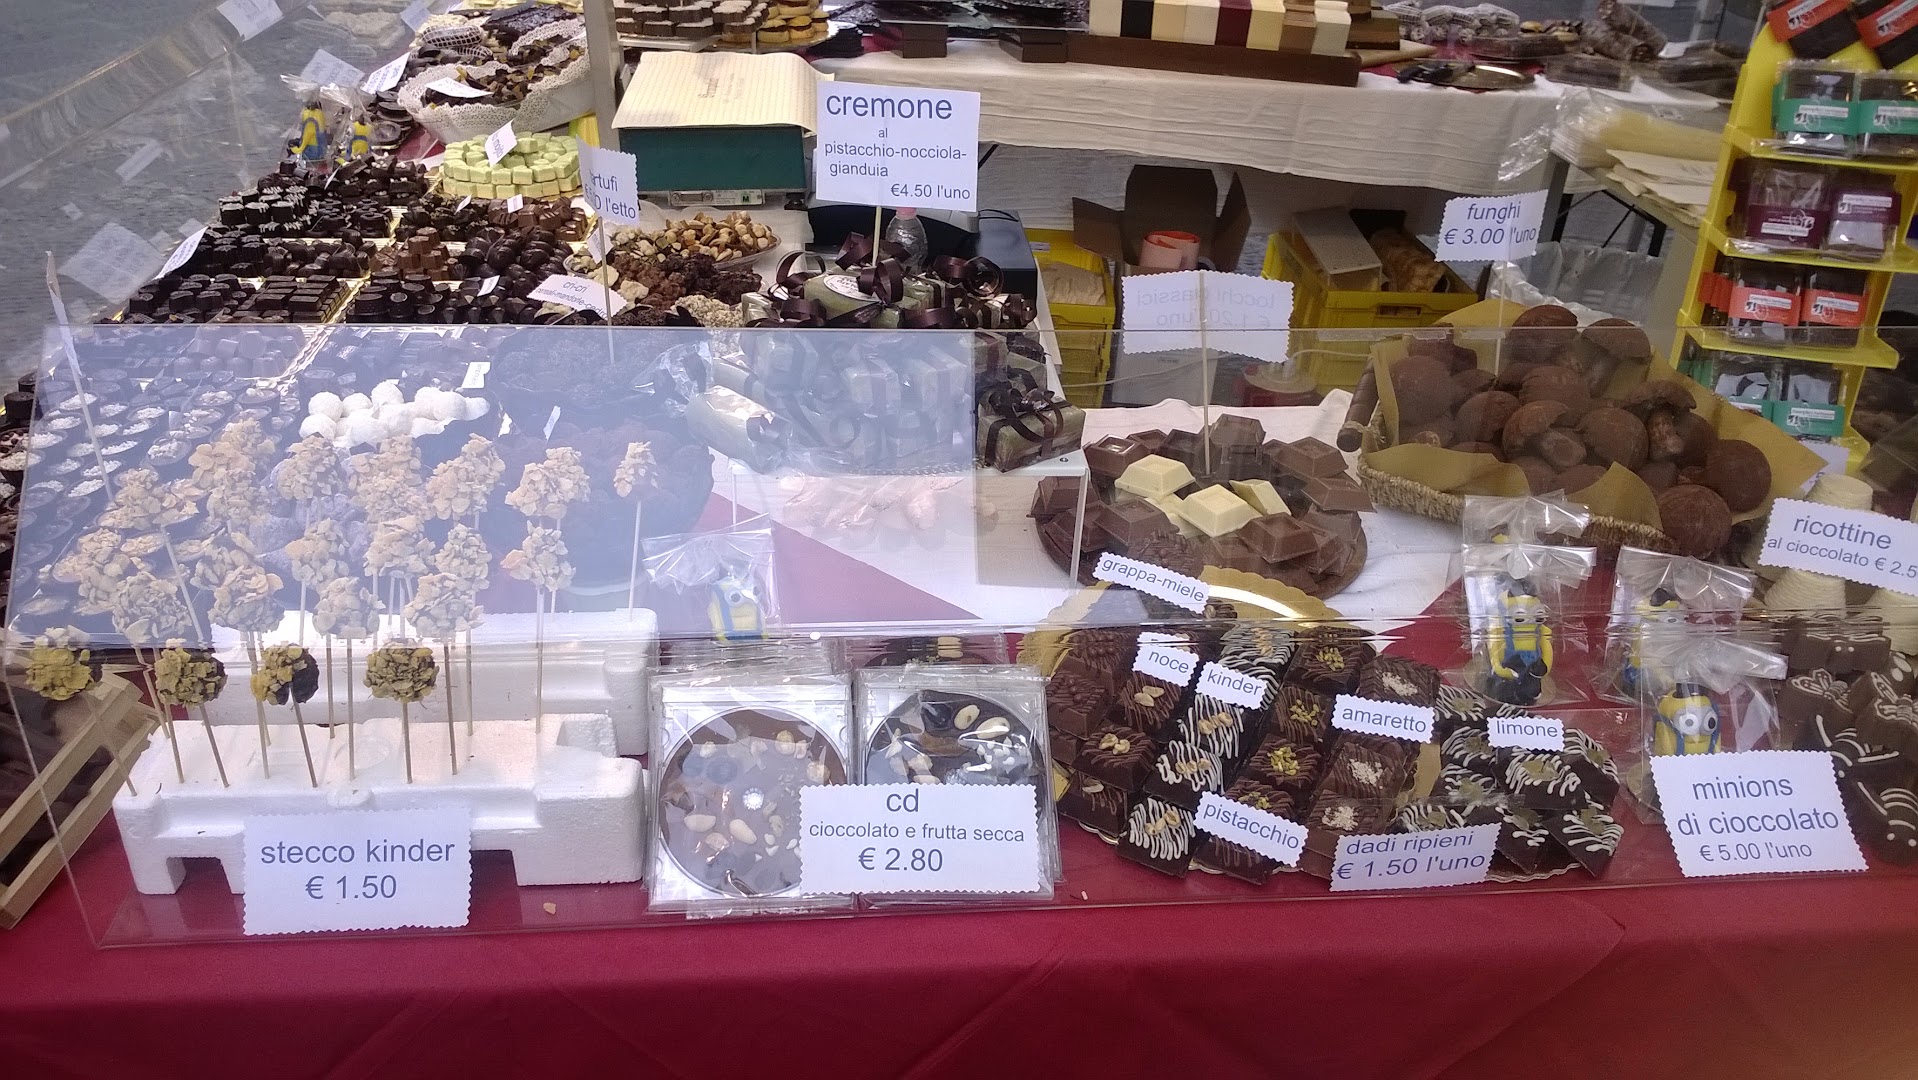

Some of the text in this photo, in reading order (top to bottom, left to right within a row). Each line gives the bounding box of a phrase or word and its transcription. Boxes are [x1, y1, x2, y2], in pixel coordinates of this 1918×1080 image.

[826, 94, 953, 120] cremone
[878, 128, 888, 138] al
[824, 141, 967, 160] pistacchio-nocciola-
[829, 161, 889, 177] gianduia
[890, 183, 971, 200] €4.50 l'uno
[605, 197, 636, 219] l'etto
[1467, 201, 1521, 224] funghi
[1443, 227, 1537, 245] € 3.00 l'uno
[1793, 515, 1892, 549] ricottine
[1767, 537, 1782, 549] al
[1786, 540, 1869, 567] cioccolato
[1875, 557, 1887, 571] €
[1101, 559, 1204, 602] grappa-miele
[1148, 651, 1189, 674] noce
[1207, 669, 1262, 695] kinder
[1342, 707, 1427, 733] amaretto
[1496, 720, 1559, 738] limone
[1692, 775, 1793, 800] minions
[886, 788, 919, 813] cd
[809, 822, 1025, 842] cioccolato e frutta secca
[1203, 803, 1299, 849] pistacchio
[1677, 808, 1839, 836] di cioccolato
[260, 838, 455, 864] stecco kinder
[1346, 830, 1474, 855] dadi ripieni
[1699, 841, 1813, 861] € 5.00 l'uno
[858, 847, 943, 872] € 2.80
[1336, 854, 1486, 880] € 1.50 l'uno
[305, 874, 397, 900] € 1.50
